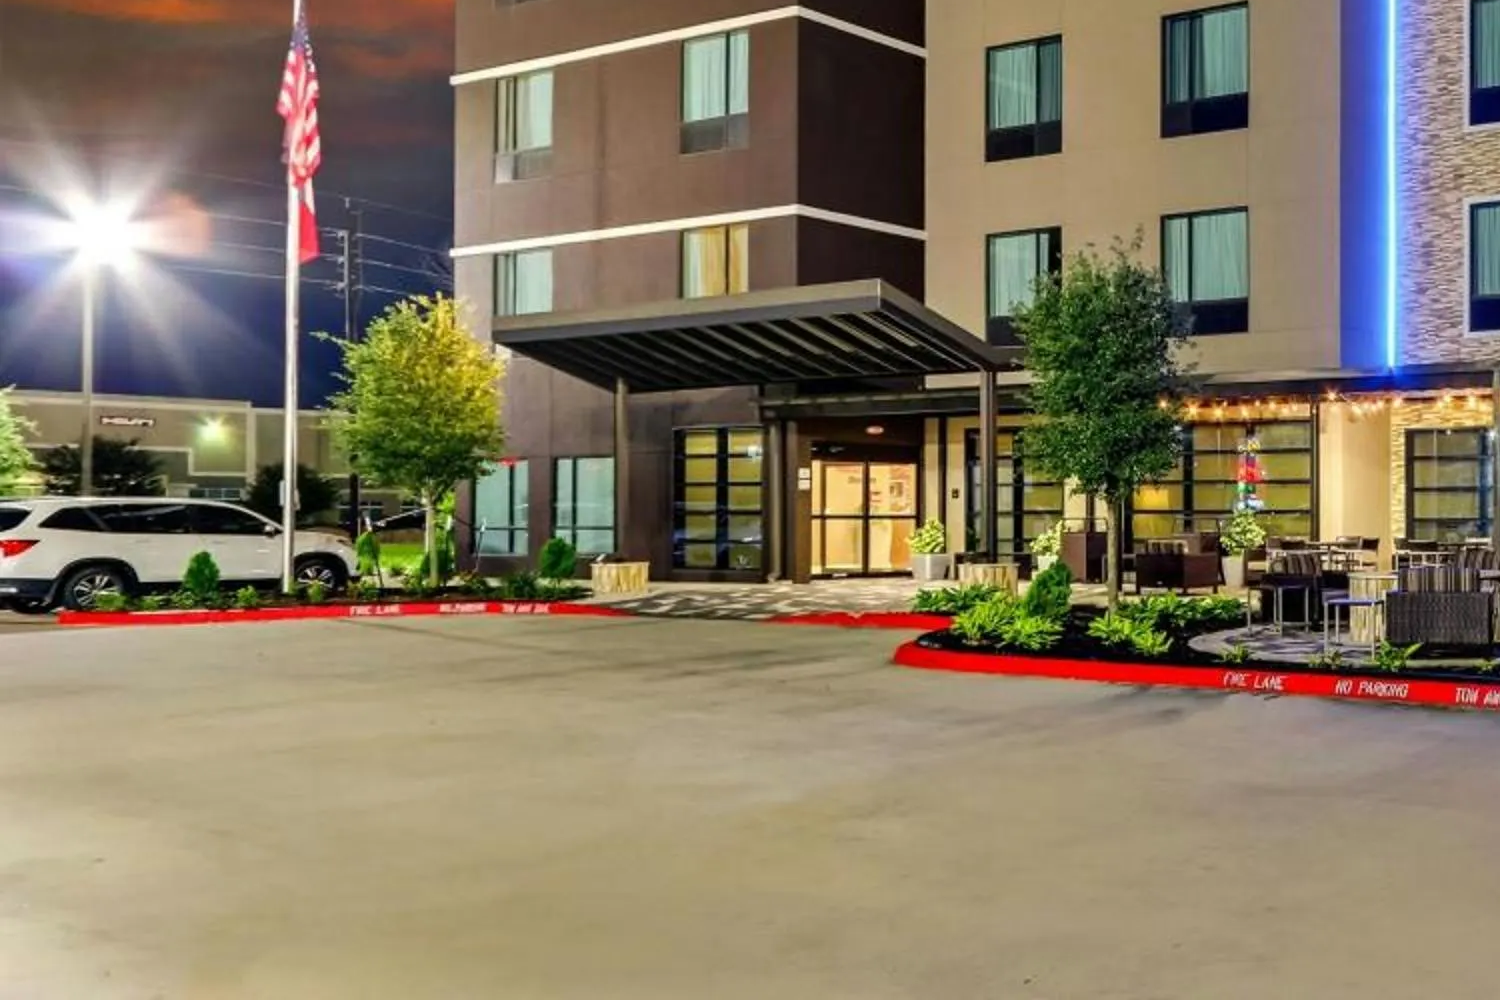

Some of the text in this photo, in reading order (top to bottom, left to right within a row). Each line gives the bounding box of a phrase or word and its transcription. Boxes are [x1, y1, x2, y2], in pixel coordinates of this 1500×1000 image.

[1223, 671, 1287, 691] FIRE LANE
[1335, 679, 1409, 698] NO PARKING
